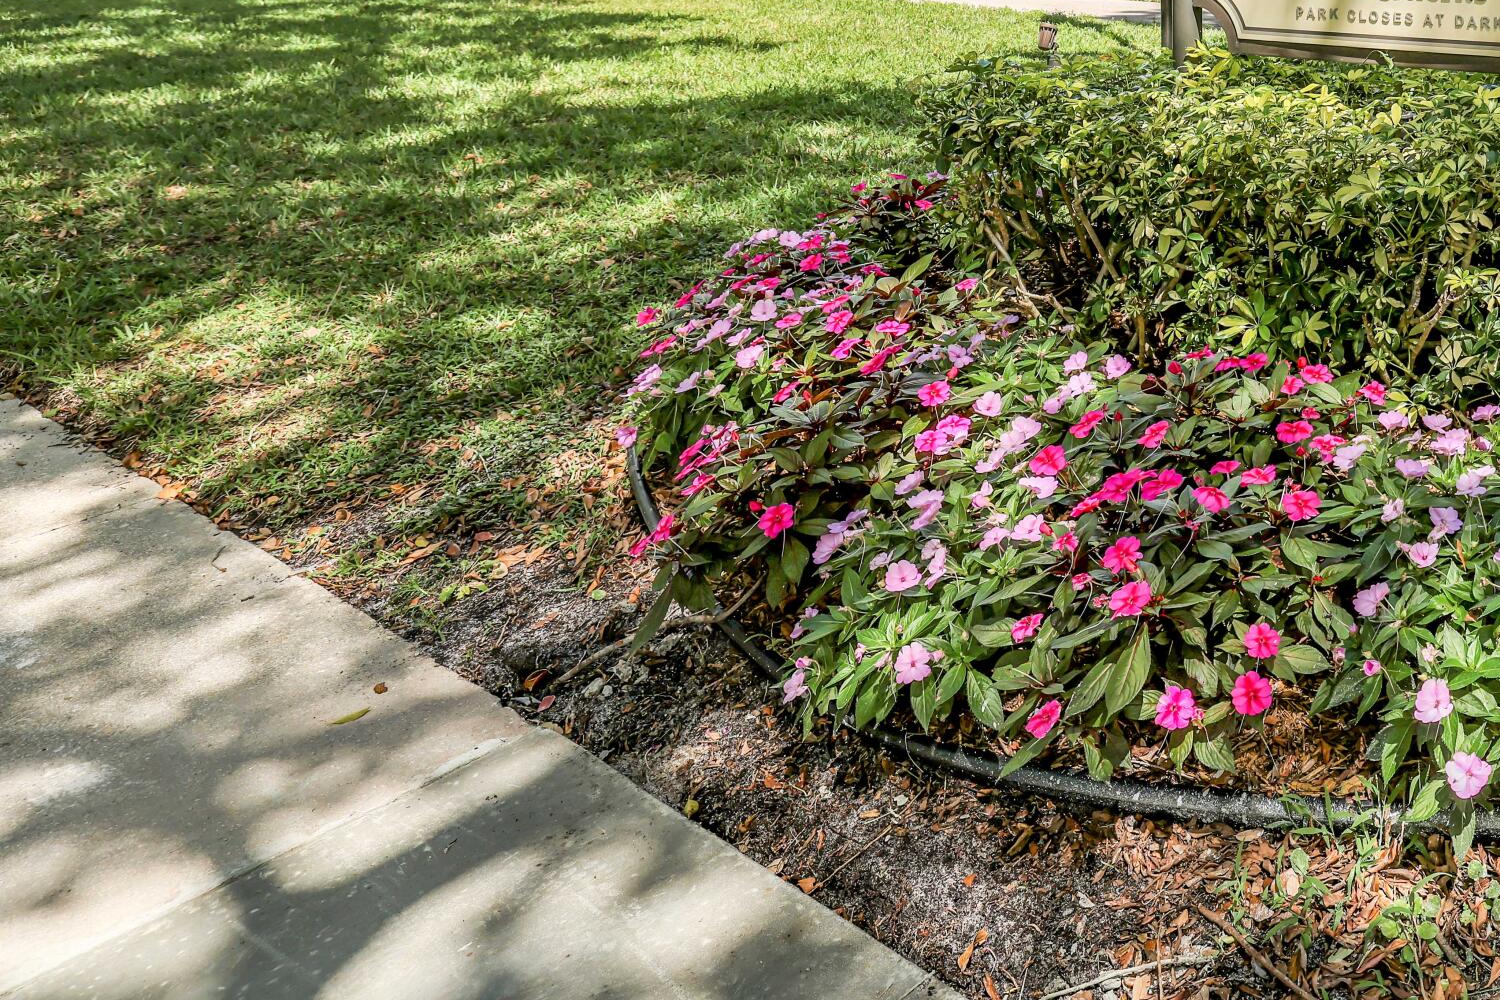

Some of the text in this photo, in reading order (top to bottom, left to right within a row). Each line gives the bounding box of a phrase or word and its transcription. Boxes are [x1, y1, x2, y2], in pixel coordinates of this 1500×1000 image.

[1295, 6, 1339, 21] PARK
[1347, 10, 1413, 26] CLOSES
[1422, 13, 1445, 28] AT
